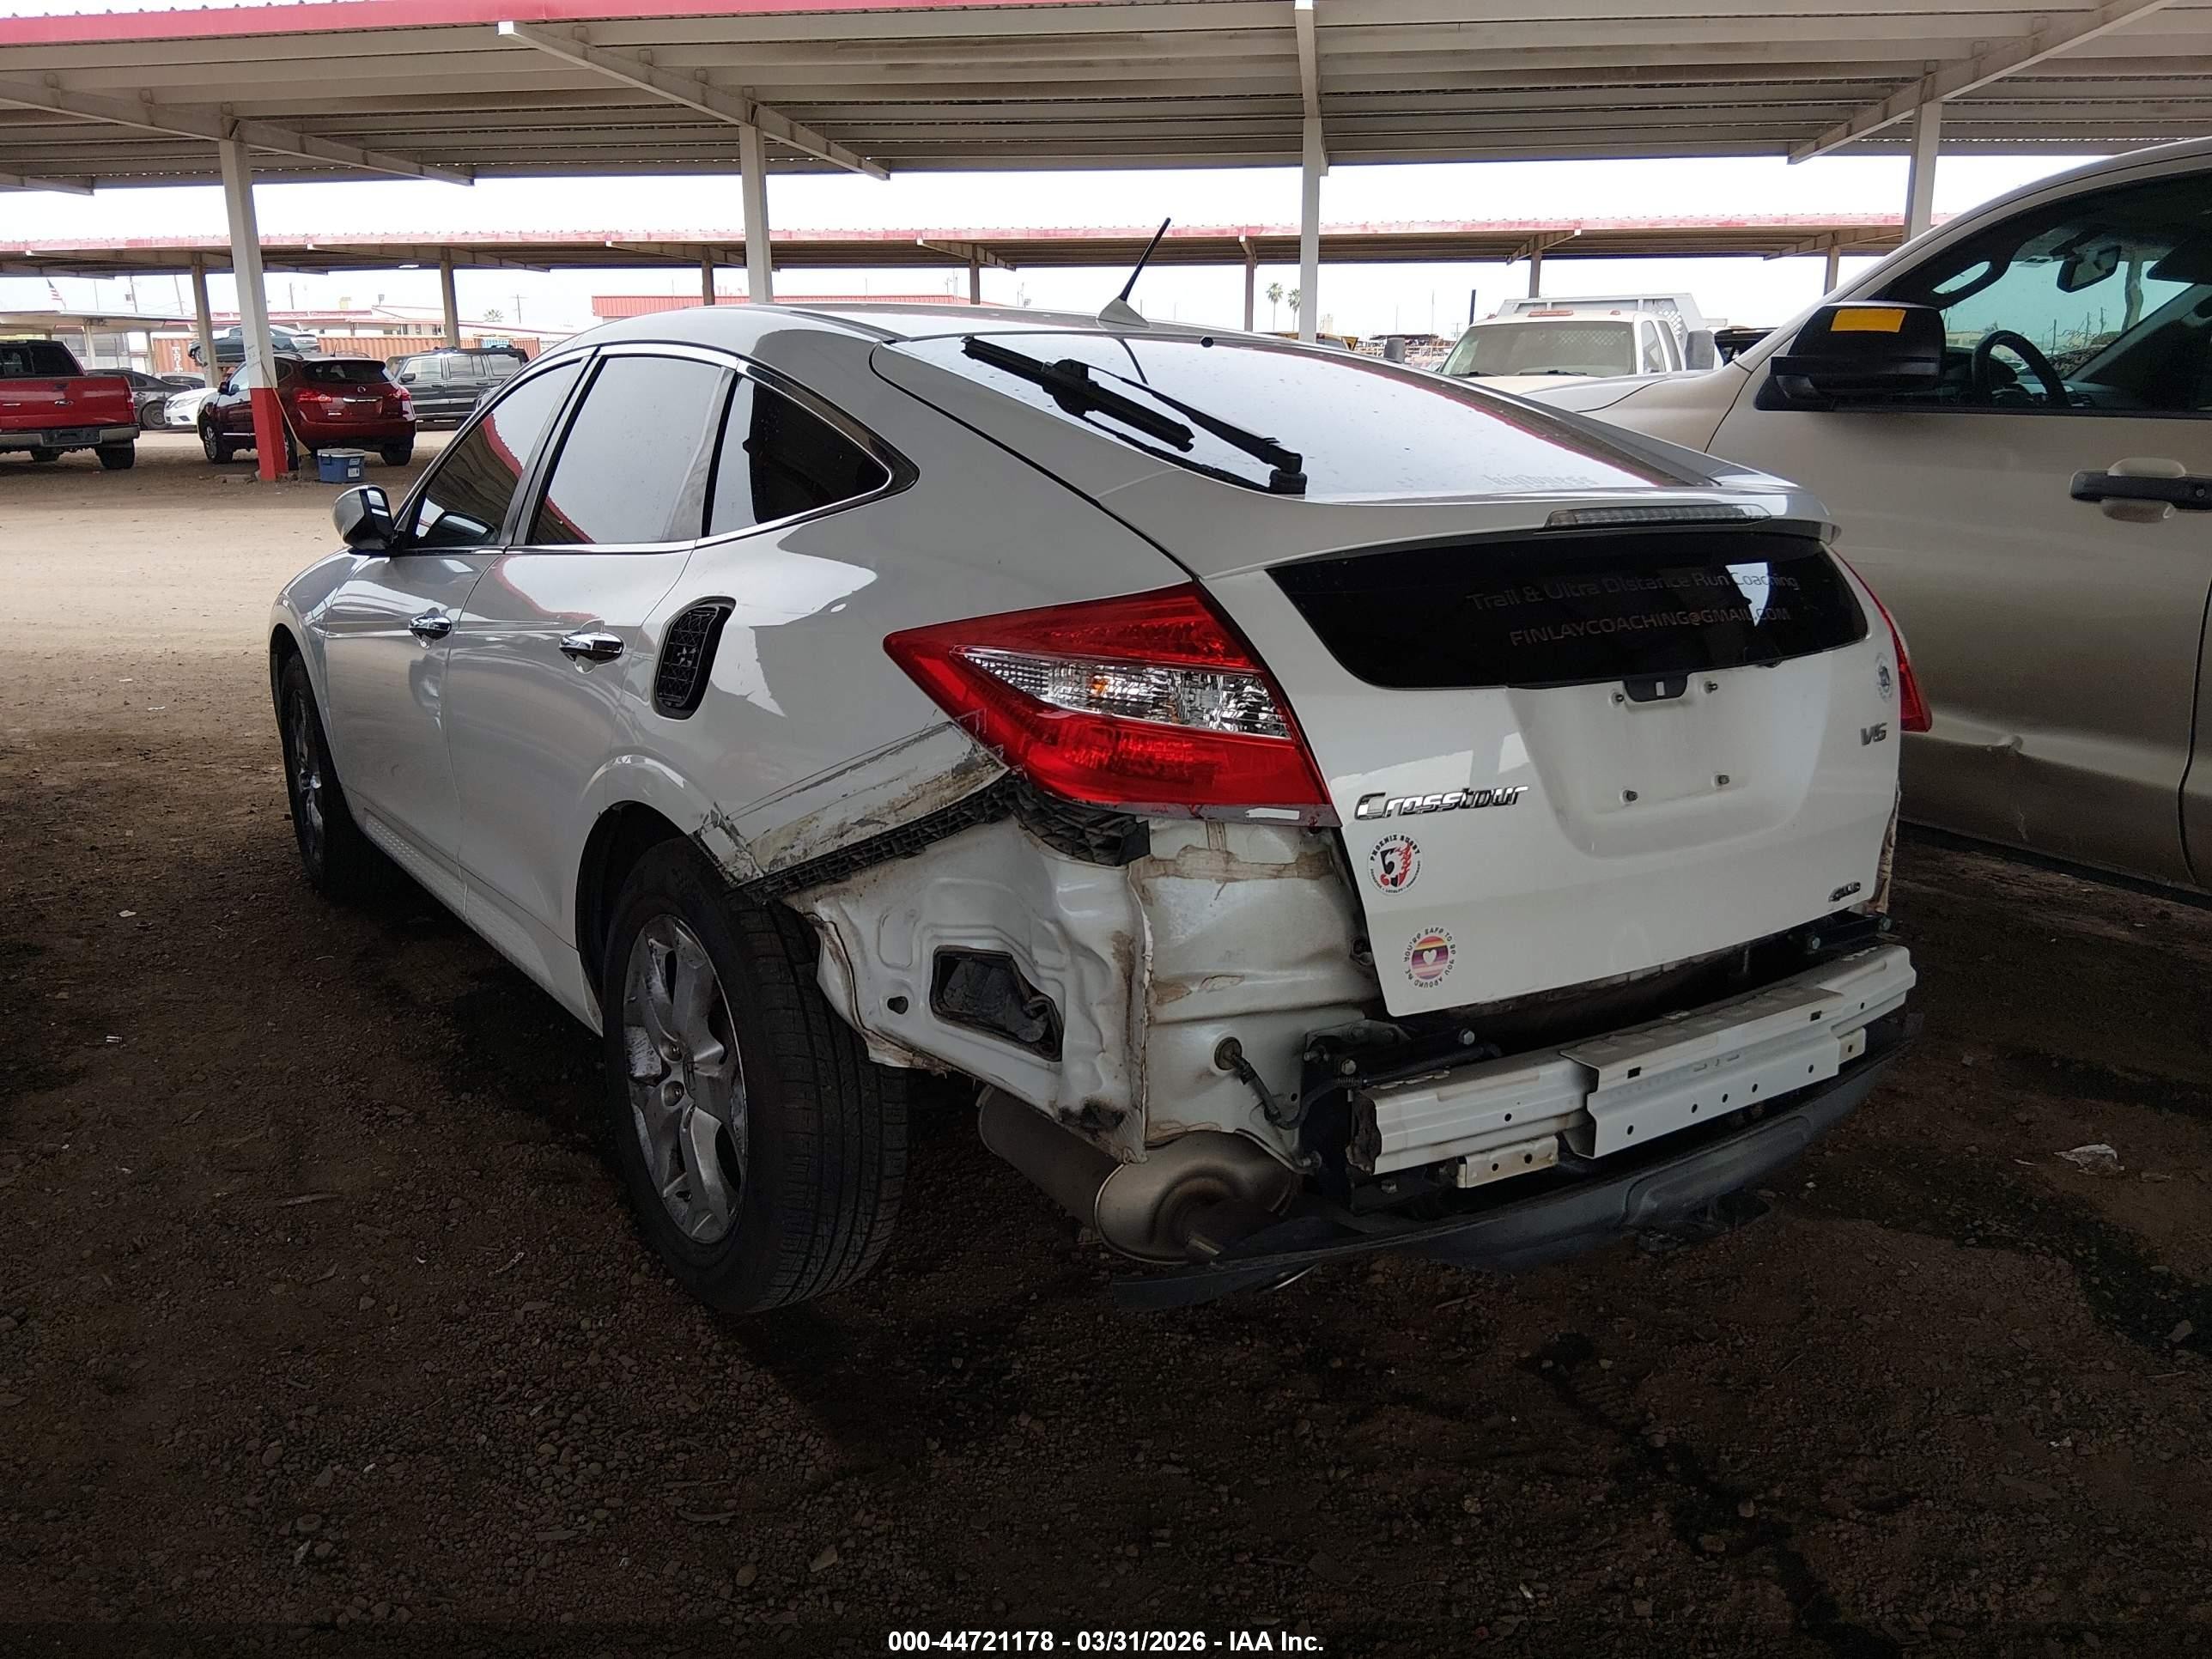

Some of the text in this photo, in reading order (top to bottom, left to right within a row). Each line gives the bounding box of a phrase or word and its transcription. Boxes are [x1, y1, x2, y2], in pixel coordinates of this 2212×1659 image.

[1465, 571, 1800, 610] Trail & Ultra Distance Run Coaching
[1510, 608, 1791, 646] FINLAYCOACHING@GMAIL.COM
[1860, 722, 1887, 745] V6
[1354, 786, 1528, 820] Crosstour
[1370, 834, 1421, 861] PHOENIX RUGBY
[1444, 932, 1453, 942] TO
[1444, 959, 1455, 975] YOU
[1414, 976, 1443, 988] AROUND
